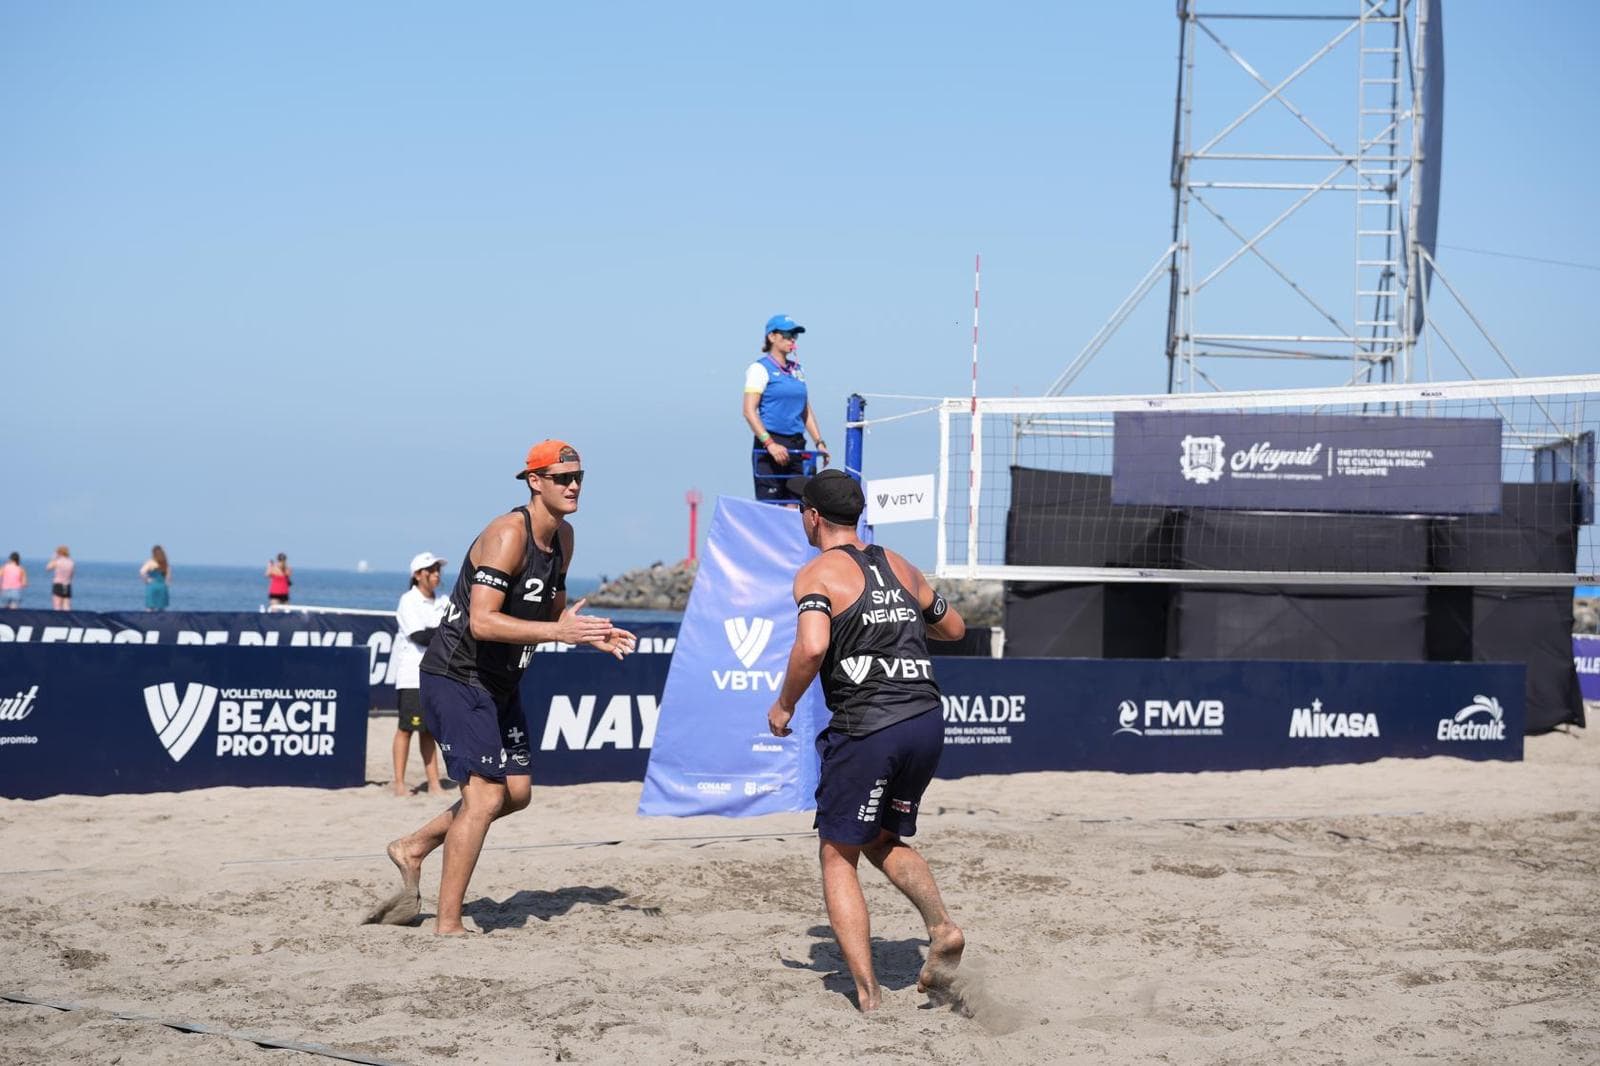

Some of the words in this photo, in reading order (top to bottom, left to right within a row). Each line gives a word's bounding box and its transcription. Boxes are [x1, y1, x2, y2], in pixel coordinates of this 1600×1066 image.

[890, 493, 924, 506] VBTV
[868, 564, 885, 587] 1
[522, 577, 545, 603] 2
[871, 588, 905, 605] SVK
[861, 607, 917, 626] NEMEC
[711, 669, 784, 692] VBTV
[0, 685, 39, 721] rit
[220, 688, 293, 699] VOLLEYBALL
[294, 689, 337, 699] WORLD
[218, 700, 337, 733] BEACH
[1144, 699, 1224, 727] FMVB
[1437, 718, 1506, 741] Electrolit
[216, 733, 269, 757] PRO
[270, 733, 335, 757] TOUR
